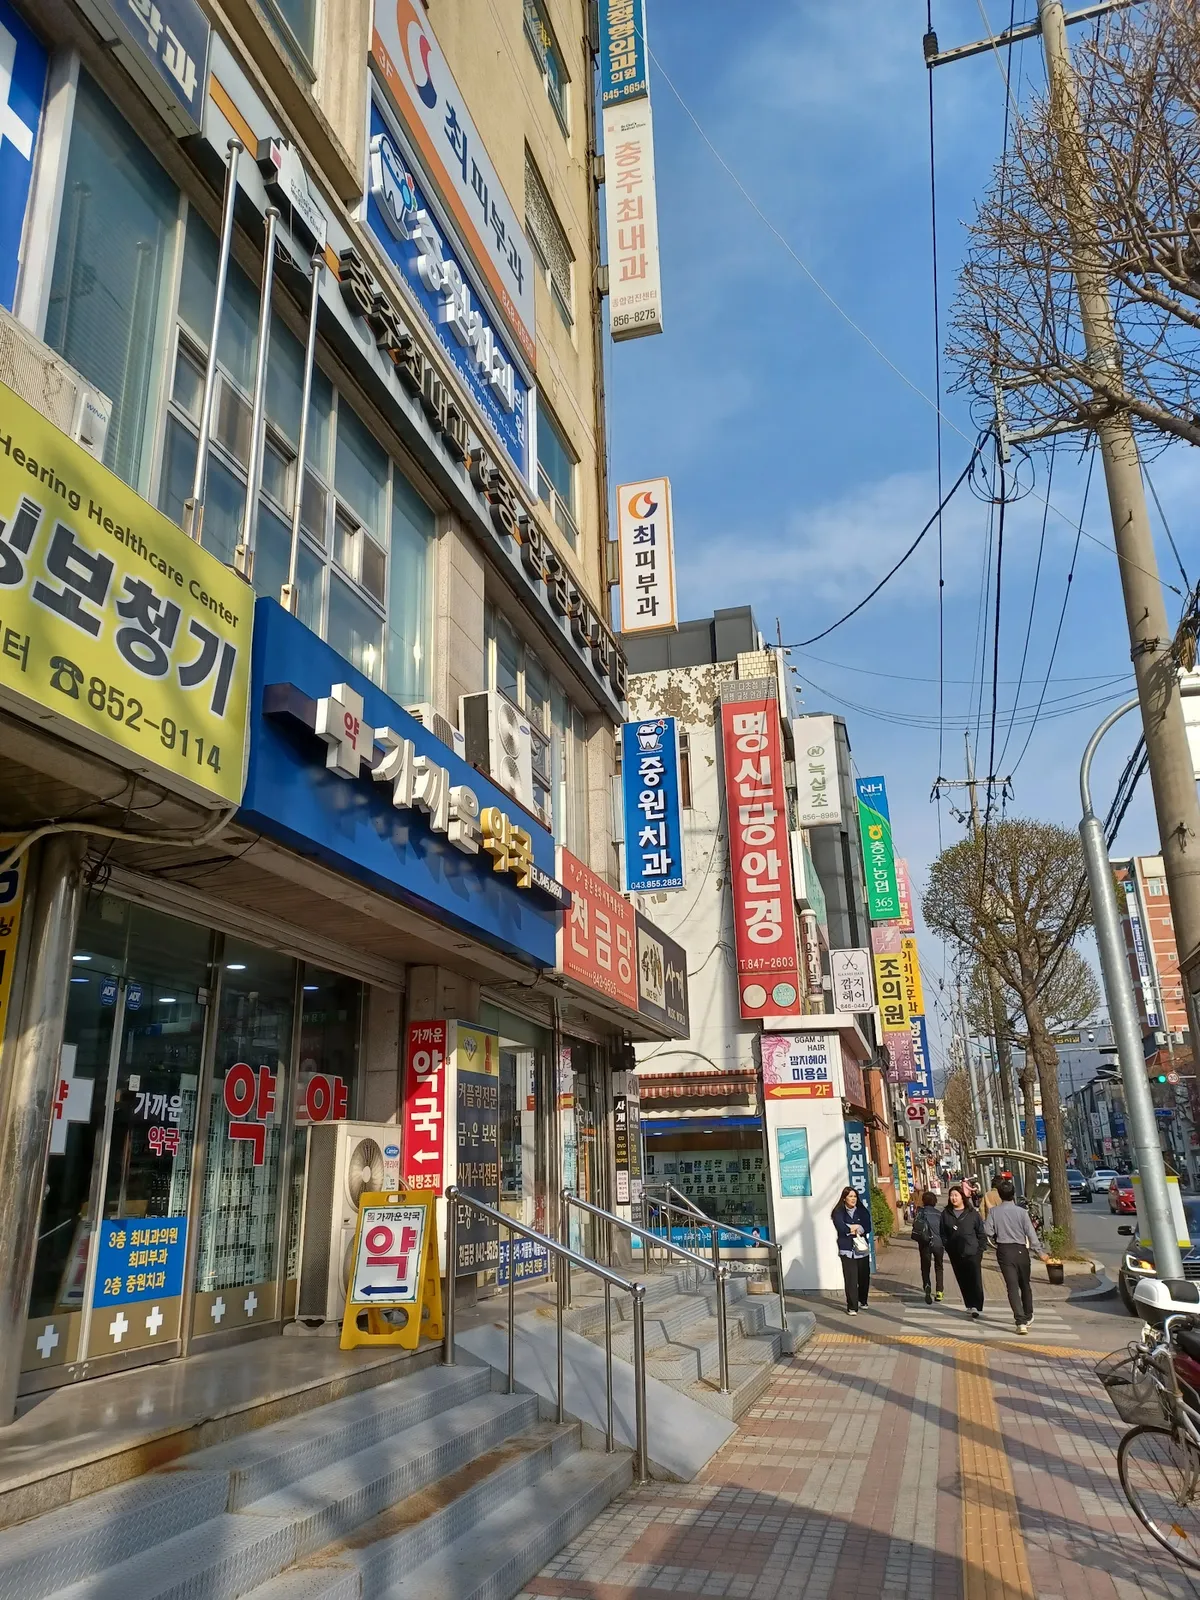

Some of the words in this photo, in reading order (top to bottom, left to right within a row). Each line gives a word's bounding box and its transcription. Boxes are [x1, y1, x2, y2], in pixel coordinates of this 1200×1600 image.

[611, 66, 636, 84] 의원
[603, 80, 646, 102] 845-8654
[444, 100, 524, 296] 최피부과
[615, 140, 649, 282] 충주최내과
[402, 208, 517, 413] 중원치과
[613, 308, 656, 328] 856-8275
[340, 247, 471, 463] 충주최내과
[86, 401, 106, 423] WINIA
[0, 430, 83, 511] Hearing
[87, 498, 185, 587] Healthcare
[189, 580, 240, 629] Center
[632, 523, 660, 617] 최피부과
[87, 675, 222, 775] 852-9114
[343, 711, 360, 751] 약
[860, 783, 883, 794] NH
[372, 726, 484, 855] 가까운
[480, 806, 534, 889] 약국
[637, 755, 674, 877] 중원치과
[802, 811, 839, 821] 856-8989
[733, 710, 783, 945] 명신당안경
[870, 840, 890, 894] 충주농협
[630, 877, 682, 890] 043.855.2882
[875, 897, 893, 908] 365
[570, 889, 633, 985] 천금당
[740, 956, 794, 970] T.847-2603
[102, 986, 116, 997] ADT
[840, 976, 864, 990] 깜지
[880, 958, 905, 1026] 조의원
[128, 991, 141, 1002] ADT
[842, 990, 866, 1002] 헤어
[411, 1028, 443, 1045] 가까운
[794, 1036, 816, 1044] GGAM
[807, 1043, 826, 1052] HAIR
[789, 1054, 828, 1066] 깜지헤어
[791, 1066, 828, 1081] 미용실
[410, 1049, 443, 1141] 약국
[458, 1082, 498, 1110] 커플링전문
[815, 1084, 830, 1096] 2F
[912, 1089, 930, 1097] 2F
[134, 1092, 184, 1122] 가까운
[224, 1062, 277, 1167] 약
[907, 1106, 926, 1125] 약
[148, 1126, 181, 1157] 약국
[481, 1124, 497, 1148] 보석
[407, 1173, 441, 1191] 처방조제
[457, 1162, 498, 1188] 시계수리전문
[108, 1230, 127, 1249] 3층
[129, 1227, 179, 1247] 최내과의원
[128, 1248, 169, 1268] 최피부과
[365, 1225, 417, 1282] 약
[459, 1243, 475, 1267] 천금당
[103, 1276, 122, 1296] 2층
[126, 1271, 166, 1293] 중원치과
